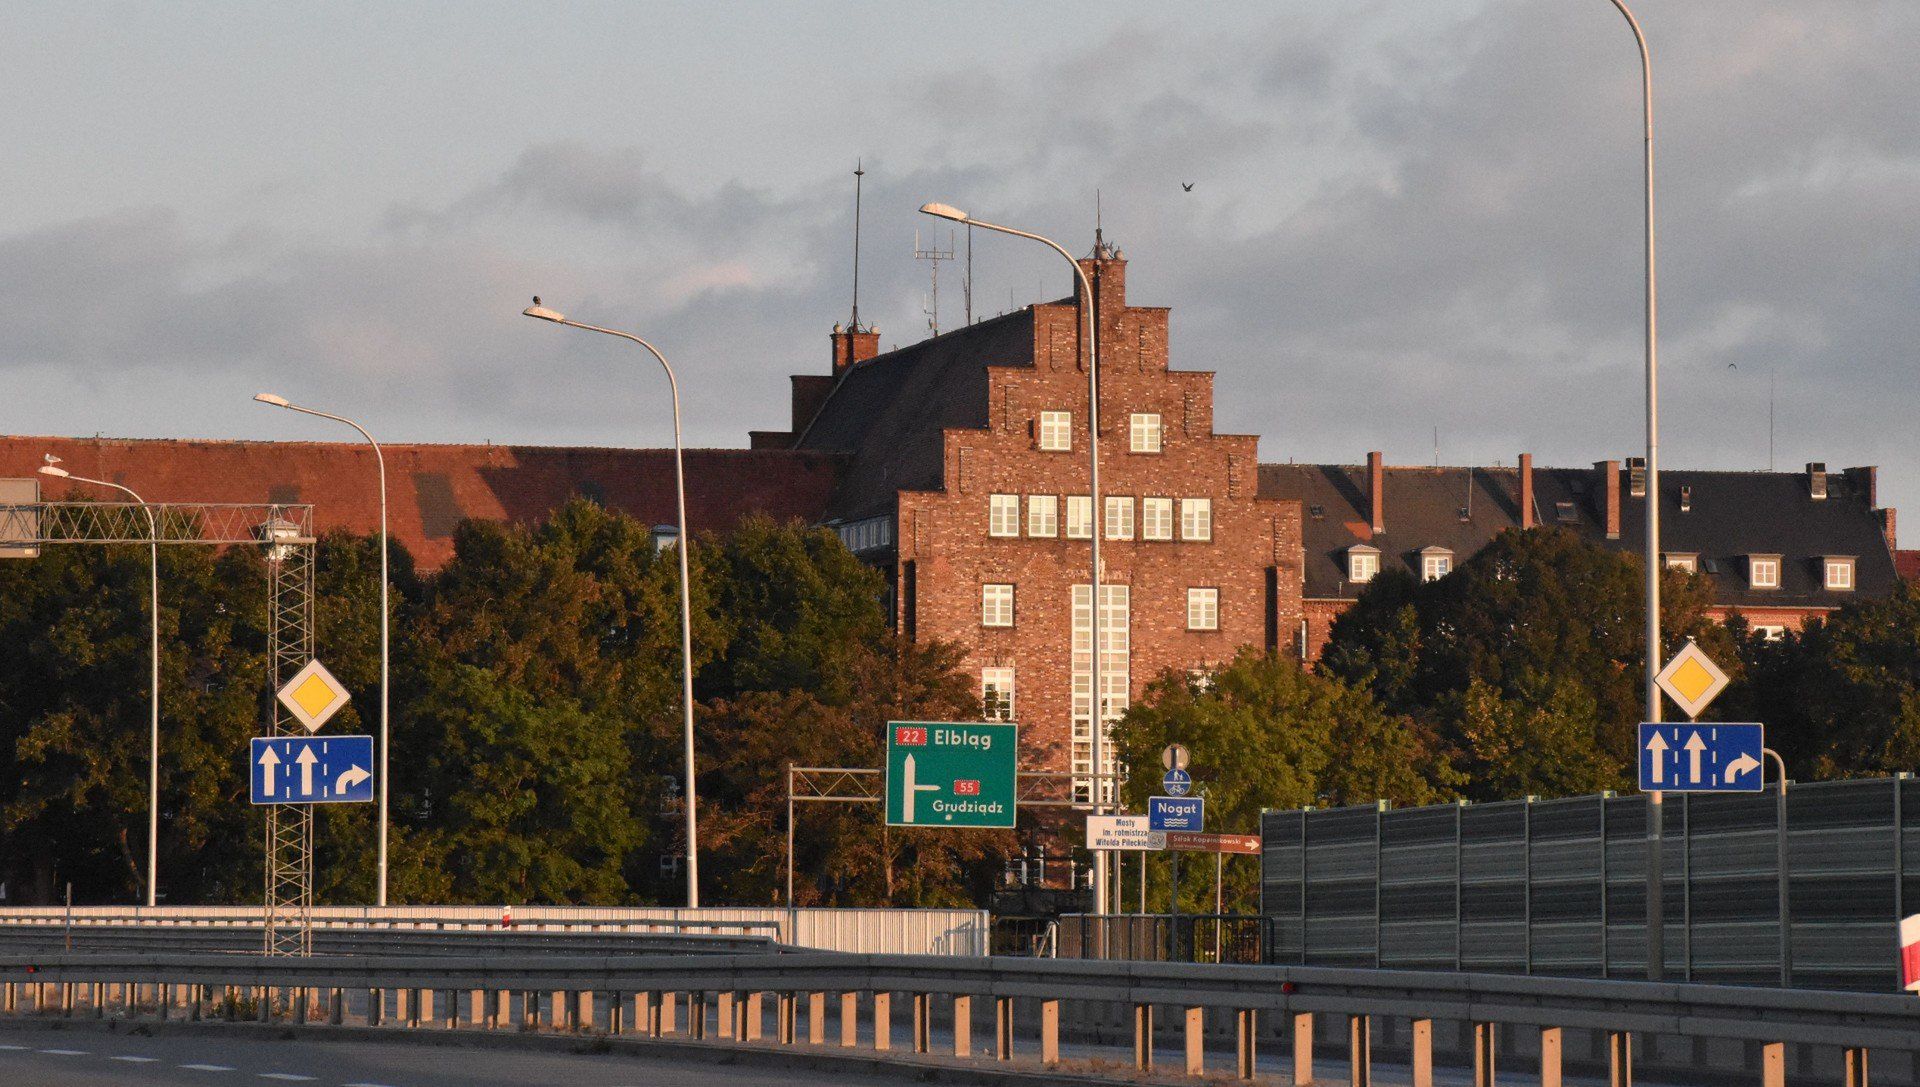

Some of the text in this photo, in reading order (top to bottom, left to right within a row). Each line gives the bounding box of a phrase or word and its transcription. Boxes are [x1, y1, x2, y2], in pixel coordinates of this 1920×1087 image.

[902, 729, 991, 750] 22 Elbląg
[960, 782, 974, 793] 55
[932, 800, 1003, 816] Grudziądz
[1158, 802, 1197, 816] Nogat
[1115, 818, 1136, 827] Mosty
[1095, 838, 1120, 846] Witolda
